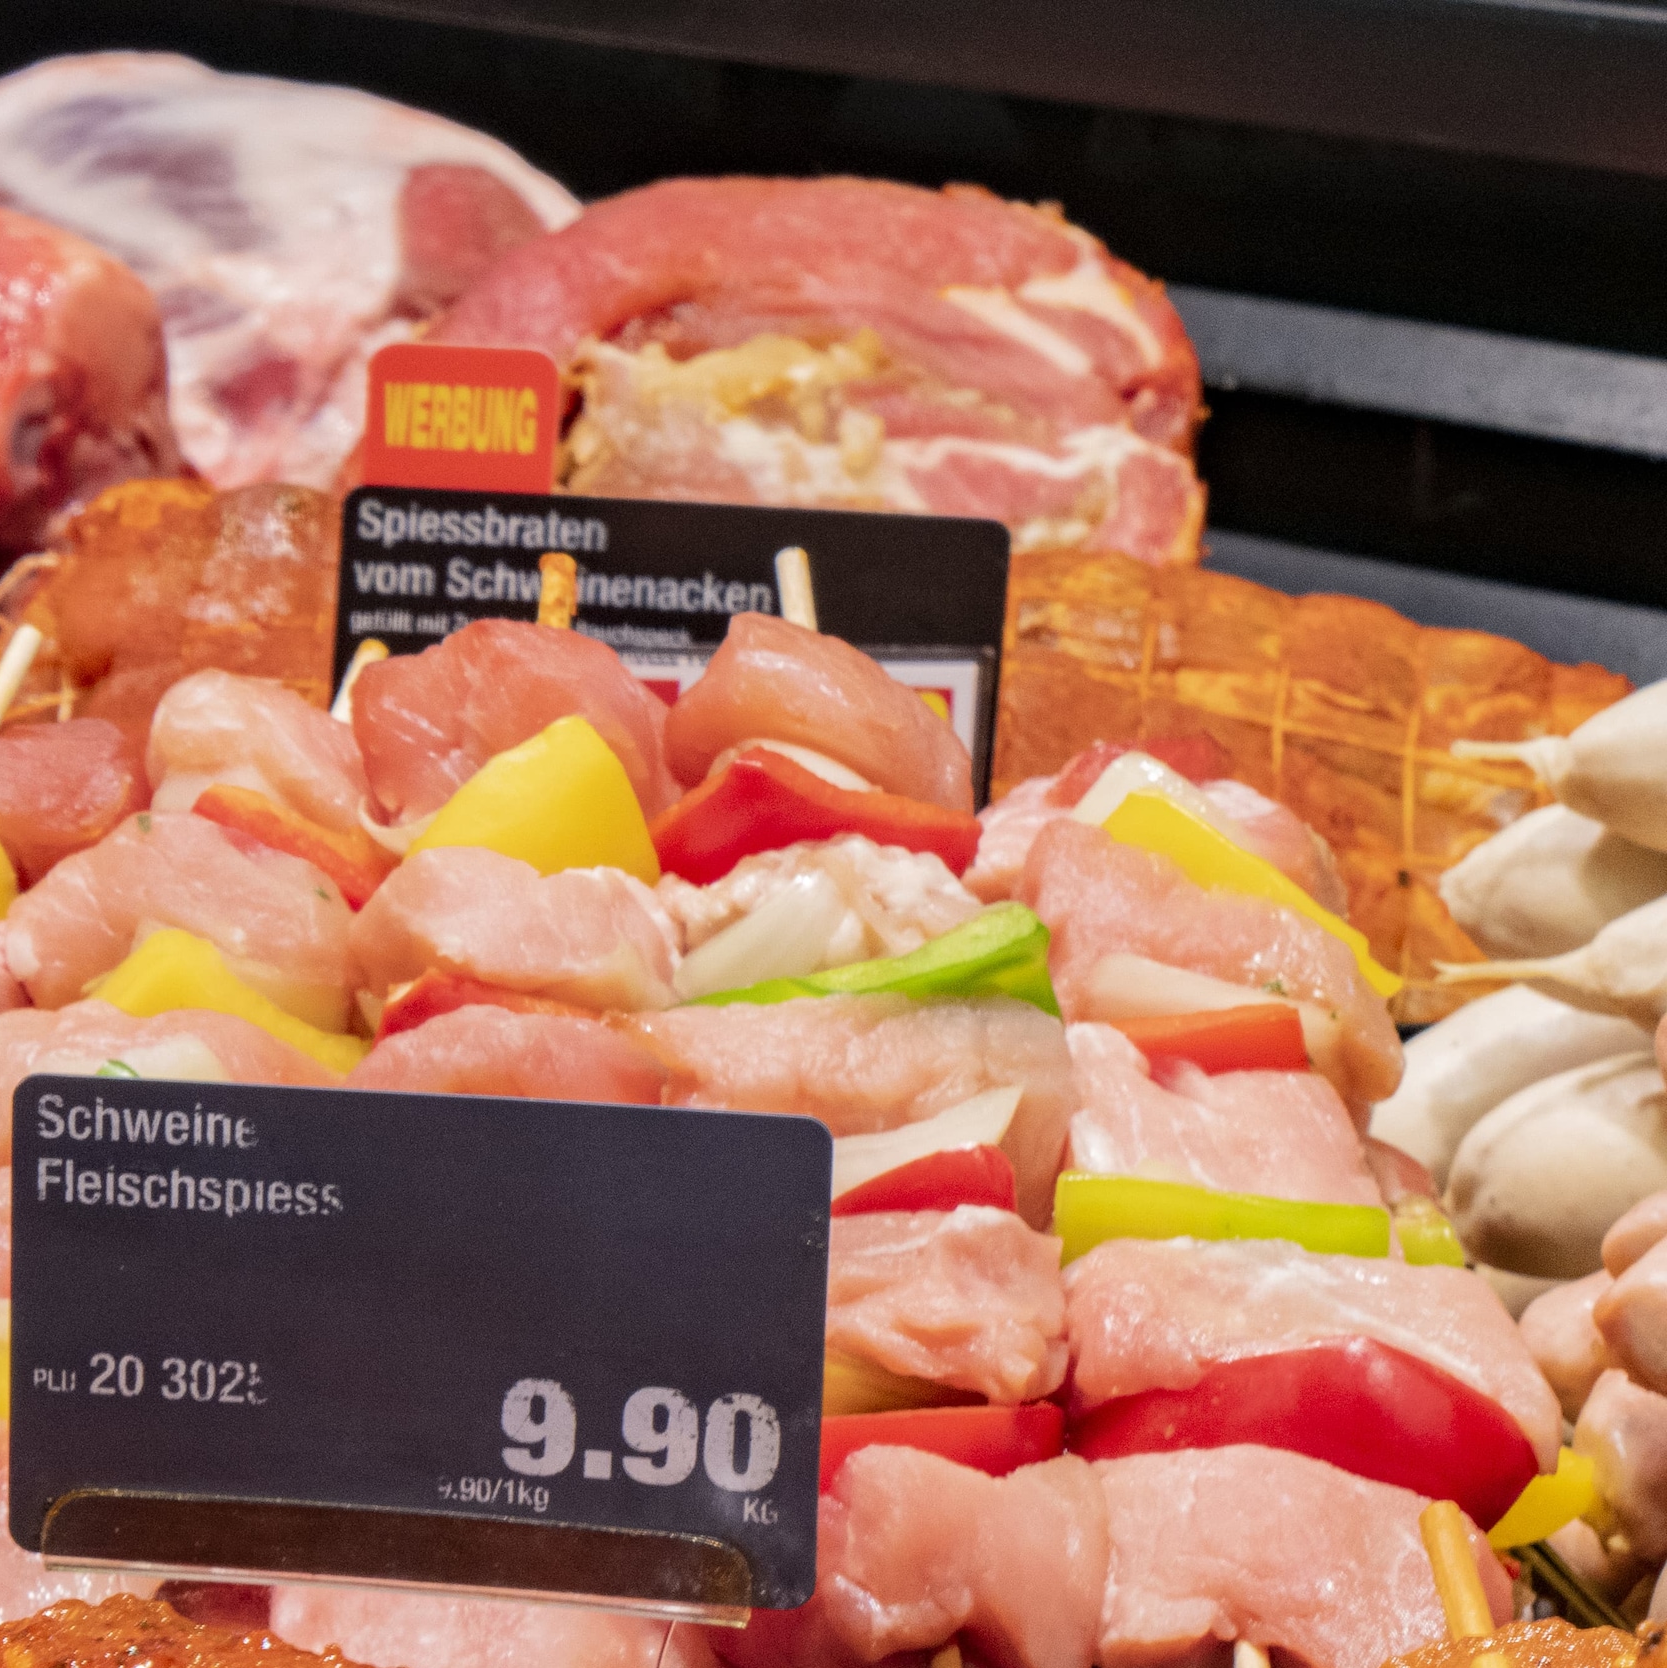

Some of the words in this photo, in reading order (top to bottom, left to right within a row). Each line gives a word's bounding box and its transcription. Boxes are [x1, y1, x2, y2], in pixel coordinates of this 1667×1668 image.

[384, 383, 538, 455] WERBUNG
[357, 499, 609, 552] Spiessbraten
[354, 560, 436, 596] vom
[445, 557, 772, 614] Schwinenacken
[37, 1093, 259, 1149] Schweine
[37, 1157, 343, 1217] Fleischspiess
[89, 1352, 145, 1398] 20
[501, 1377, 781, 1493] 9.90
